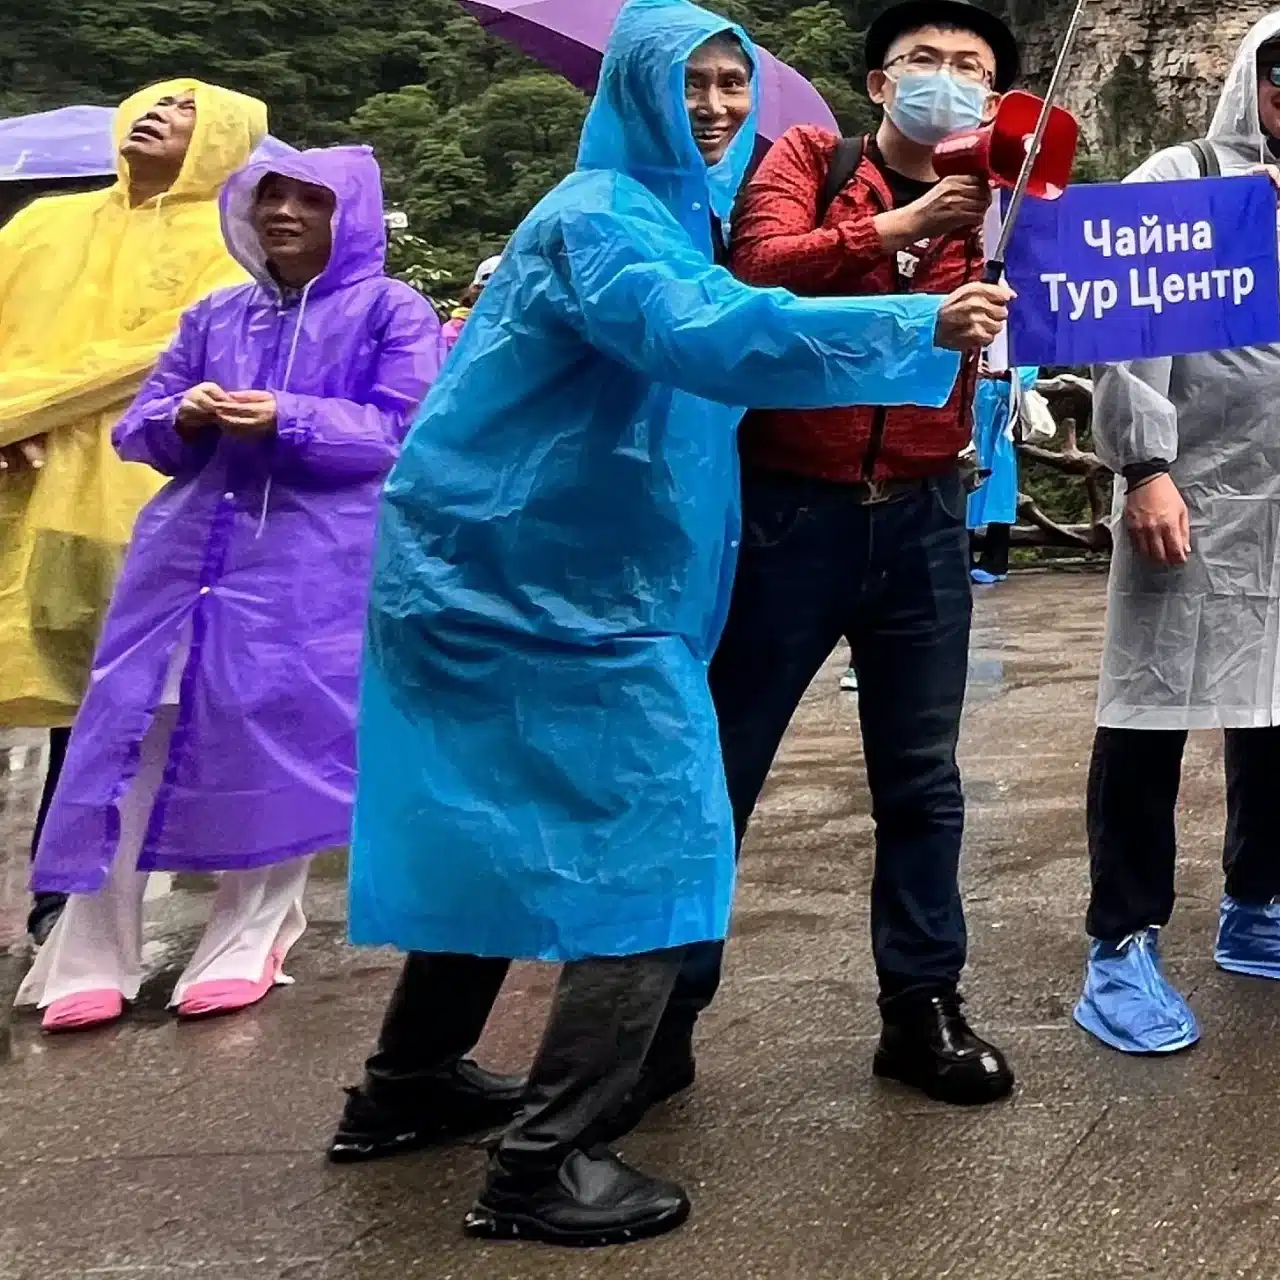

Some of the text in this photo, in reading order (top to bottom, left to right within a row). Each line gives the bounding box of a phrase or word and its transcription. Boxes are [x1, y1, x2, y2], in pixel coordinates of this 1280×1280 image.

[1083, 215, 1213, 257] Чайна
[1040, 266, 1255, 321] Тур Центр
